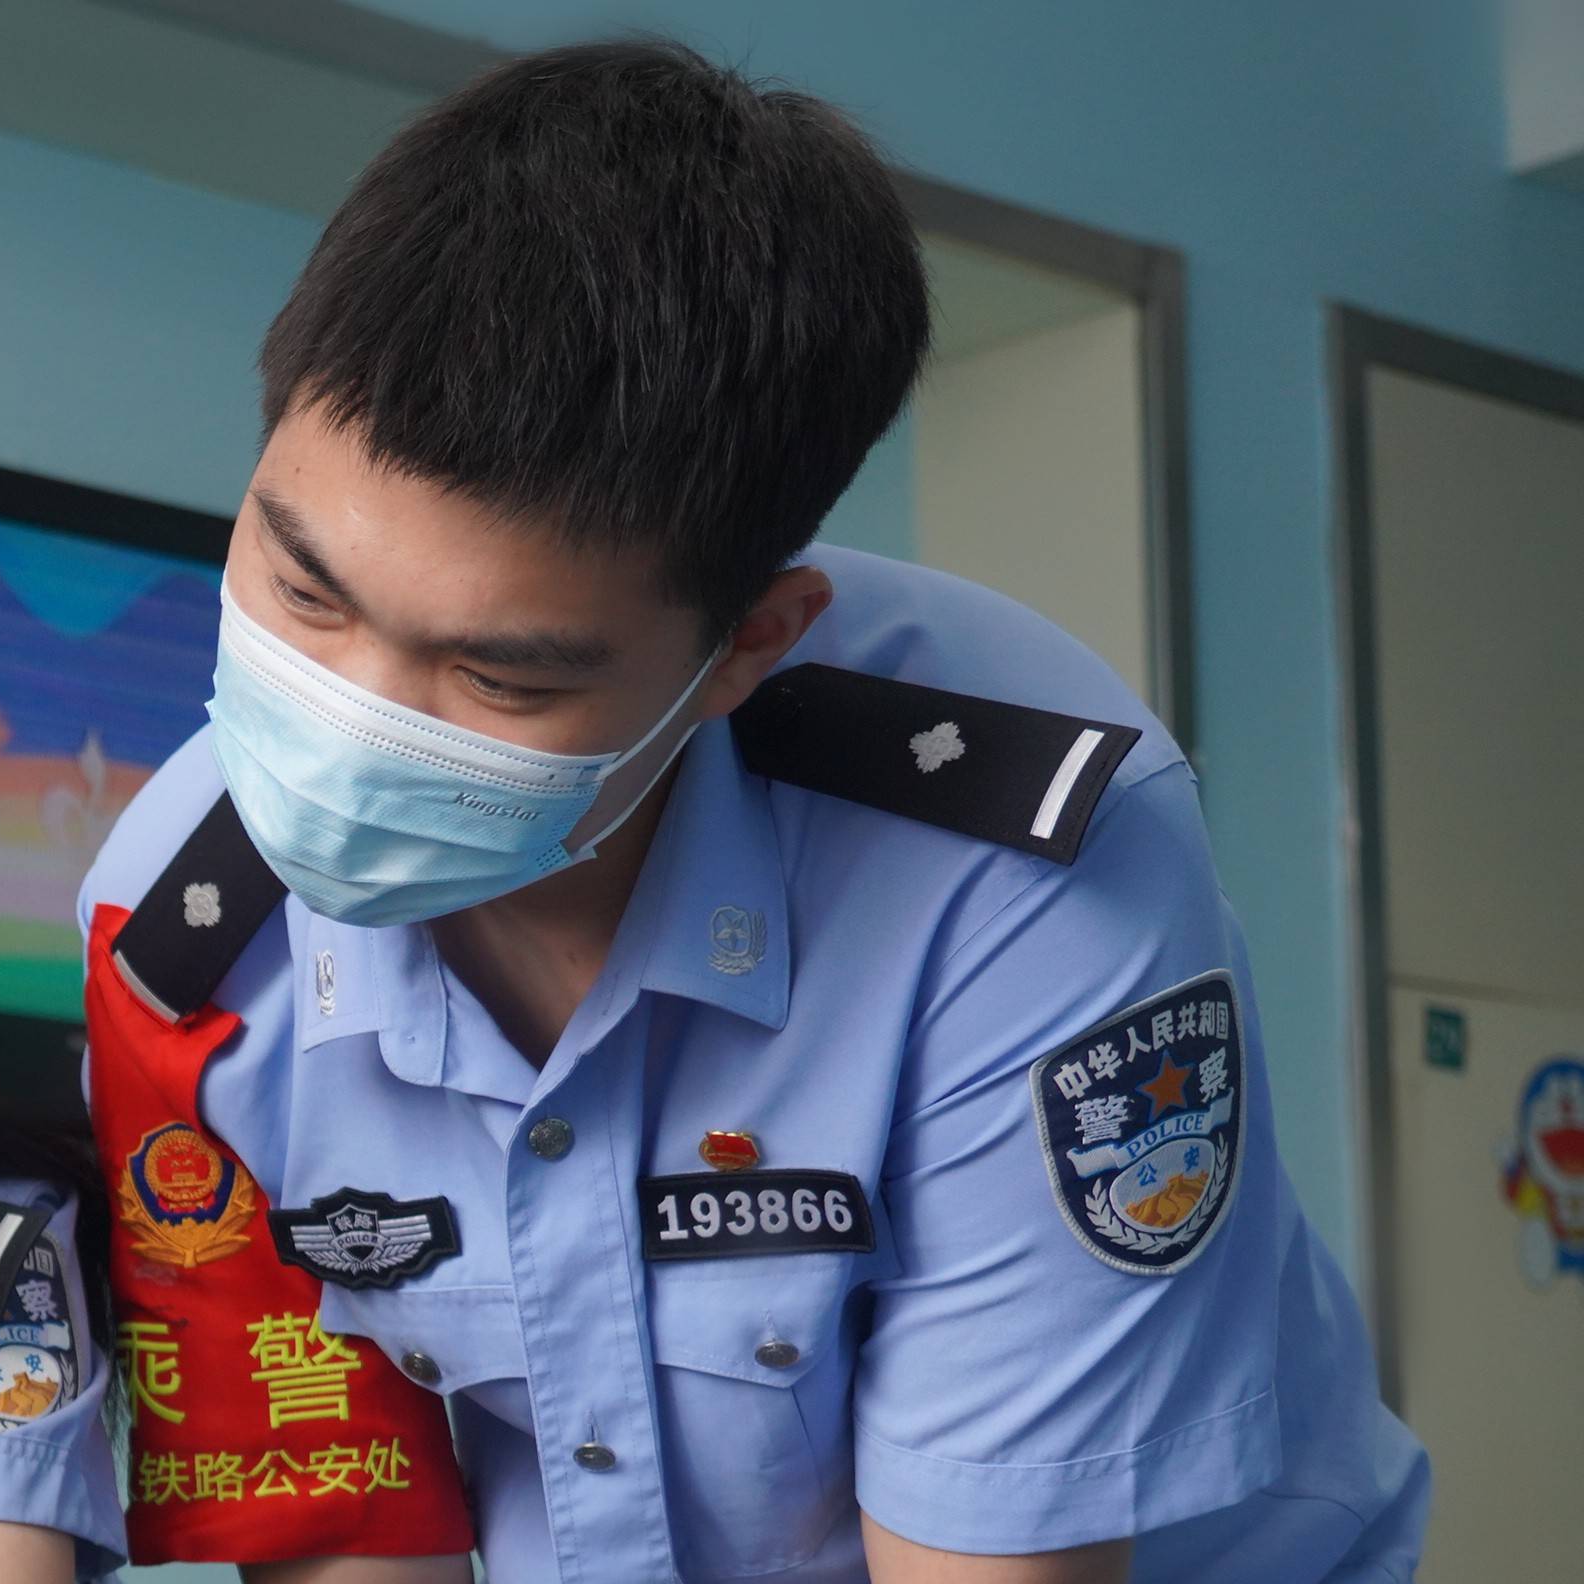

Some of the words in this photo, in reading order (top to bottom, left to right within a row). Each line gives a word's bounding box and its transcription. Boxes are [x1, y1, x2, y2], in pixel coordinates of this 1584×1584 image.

[452, 791, 545, 821] Kingstar
[1052, 1000, 1229, 1101] 中华人民共和国
[1074, 1095, 1130, 1145] 警
[1198, 1046, 1229, 1103] 察
[1127, 1112, 1206, 1160] POLICE
[1136, 1162, 1158, 1187] 公
[335, 1213, 373, 1231] 铁路
[657, 1189, 853, 1241] 193866
[337, 1233, 379, 1247] POLICE
[16, 1279, 58, 1322] 察
[25, 1353, 45, 1375] 安
[246, 1310, 362, 1429] 警
